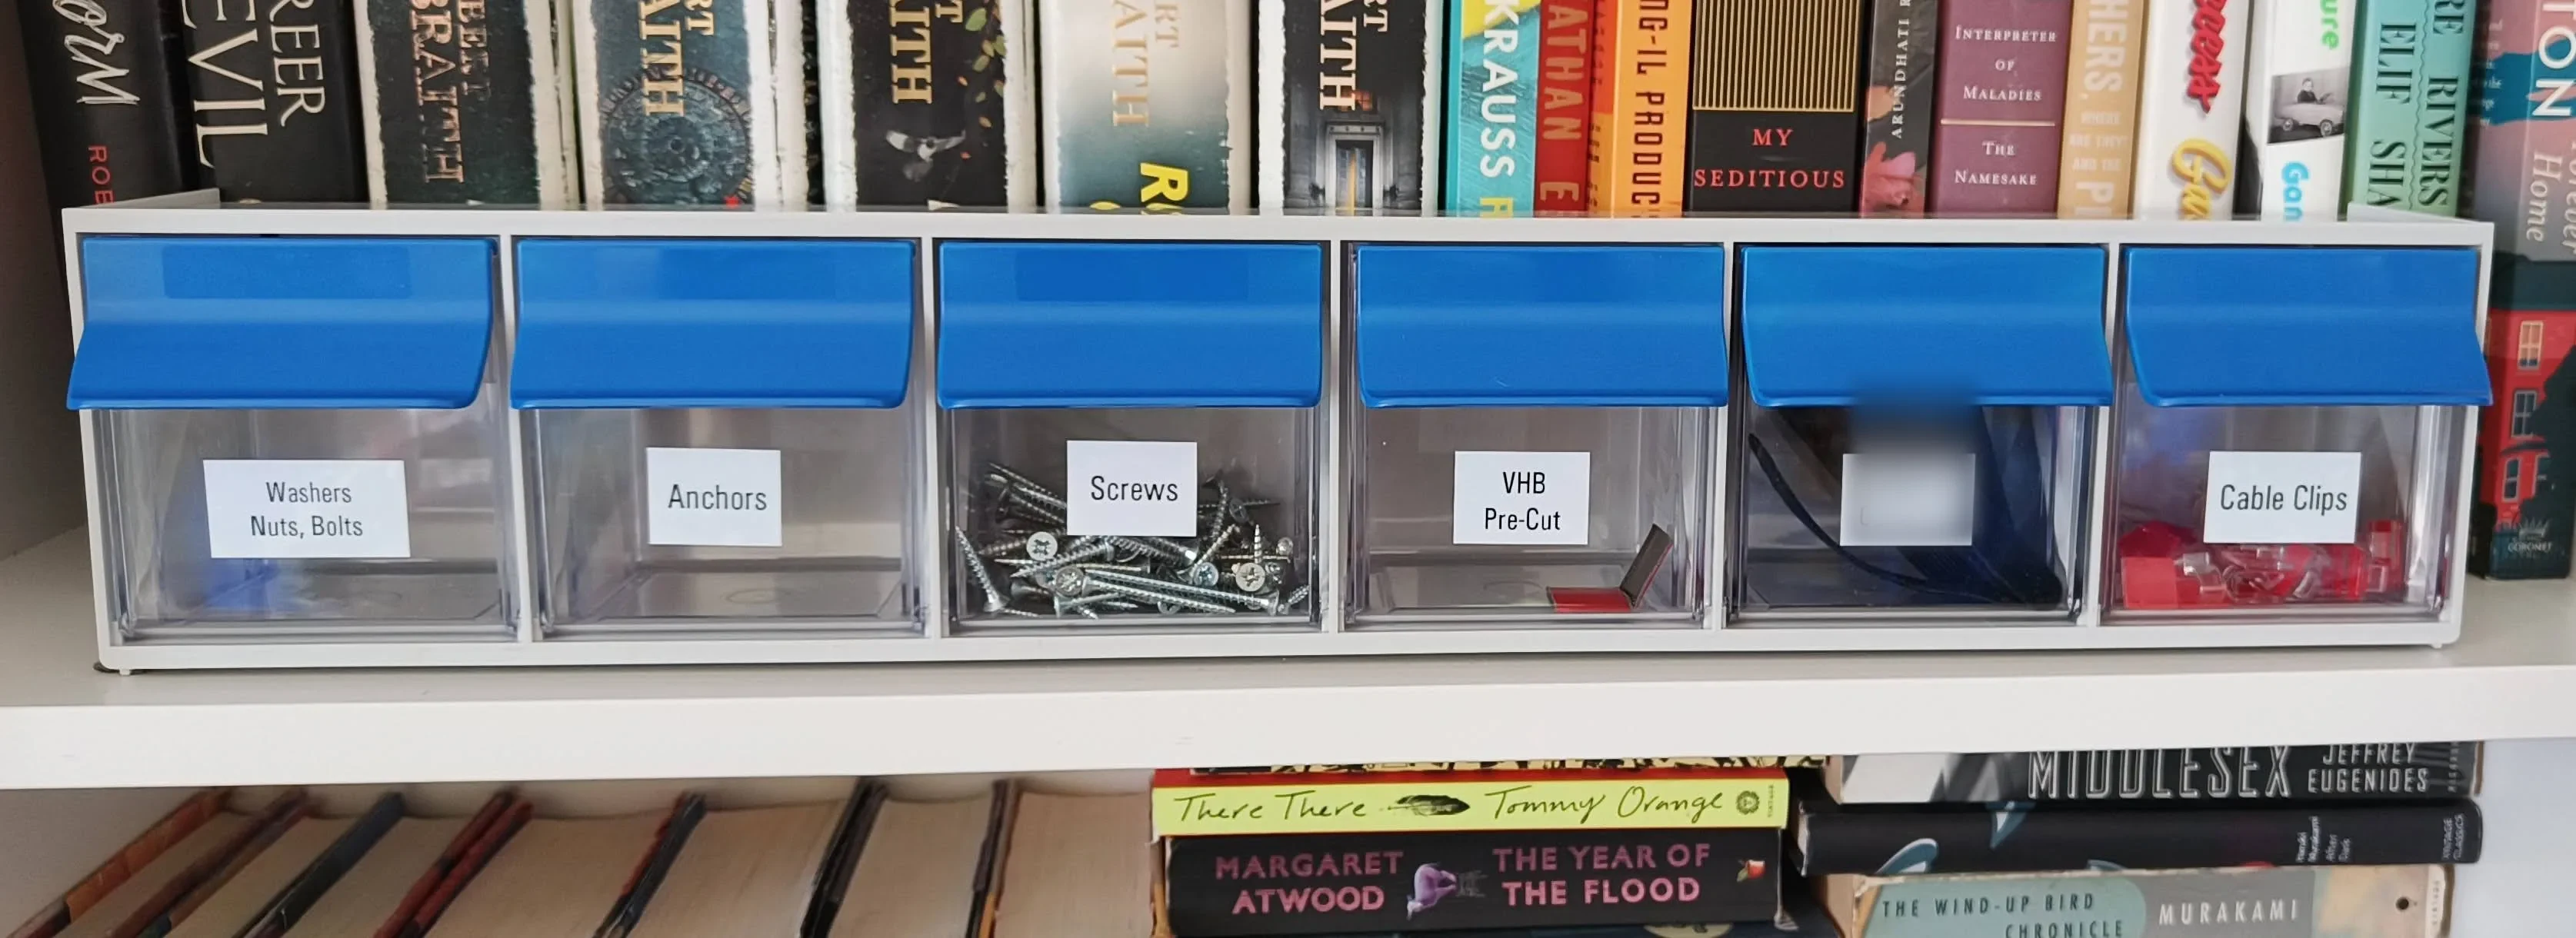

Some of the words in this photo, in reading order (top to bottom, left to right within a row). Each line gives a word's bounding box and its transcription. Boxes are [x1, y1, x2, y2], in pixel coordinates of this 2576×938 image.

[1543, 5, 1588, 140] ATHAN
[1891, 18, 1910, 139] ARUNDHATI
[2376, 23, 2417, 105] ELIF
[1480, 0, 1520, 178] KRAUSS
[1752, 128, 1794, 146] MY
[2418, 76, 2461, 208] RIVERS
[1631, 92, 1665, 212] PRODUC
[1694, 168, 1845, 188] SEDITIOUS
[2526, 151, 2563, 243] Home
[265, 481, 352, 503] Washers
[1091, 475, 1178, 501] Screws
[1502, 471, 1545, 494] VHB
[668, 484, 767, 511] Anchors
[2221, 484, 2284, 511] Cable
[2294, 484, 2348, 517] Clips
[251, 515, 305, 539] Nuts,
[312, 515, 363, 536] Bolts
[1485, 507, 1561, 531] Pre-Cut
[2321, 743, 2418, 766] JEFFREY
[2028, 745, 2293, 800] MIDDLESEX
[2307, 769, 2430, 793] EUGENIDES
[1173, 793, 1263, 821] There
[1275, 790, 1367, 820] There
[1485, 785, 1606, 824] Tommy
[1617, 785, 1724, 824] Orange
[1215, 850, 1404, 880] MARGARET
[1492, 847, 1558, 872] THE
[1569, 844, 1656, 871] YEAR
[1667, 843, 1711, 867] OF
[1232, 885, 1385, 915] ATWOOD
[1501, 880, 1568, 906] THE
[1584, 876, 1701, 905] FLOOD
[1882, 900, 1920, 917] THE
[1934, 896, 2030, 916] WIND-UP
[2045, 895, 2094, 912] BIRD
[2158, 899, 2299, 926] MURAKAMI
[2004, 920, 2123, 938] CHRONICLE
